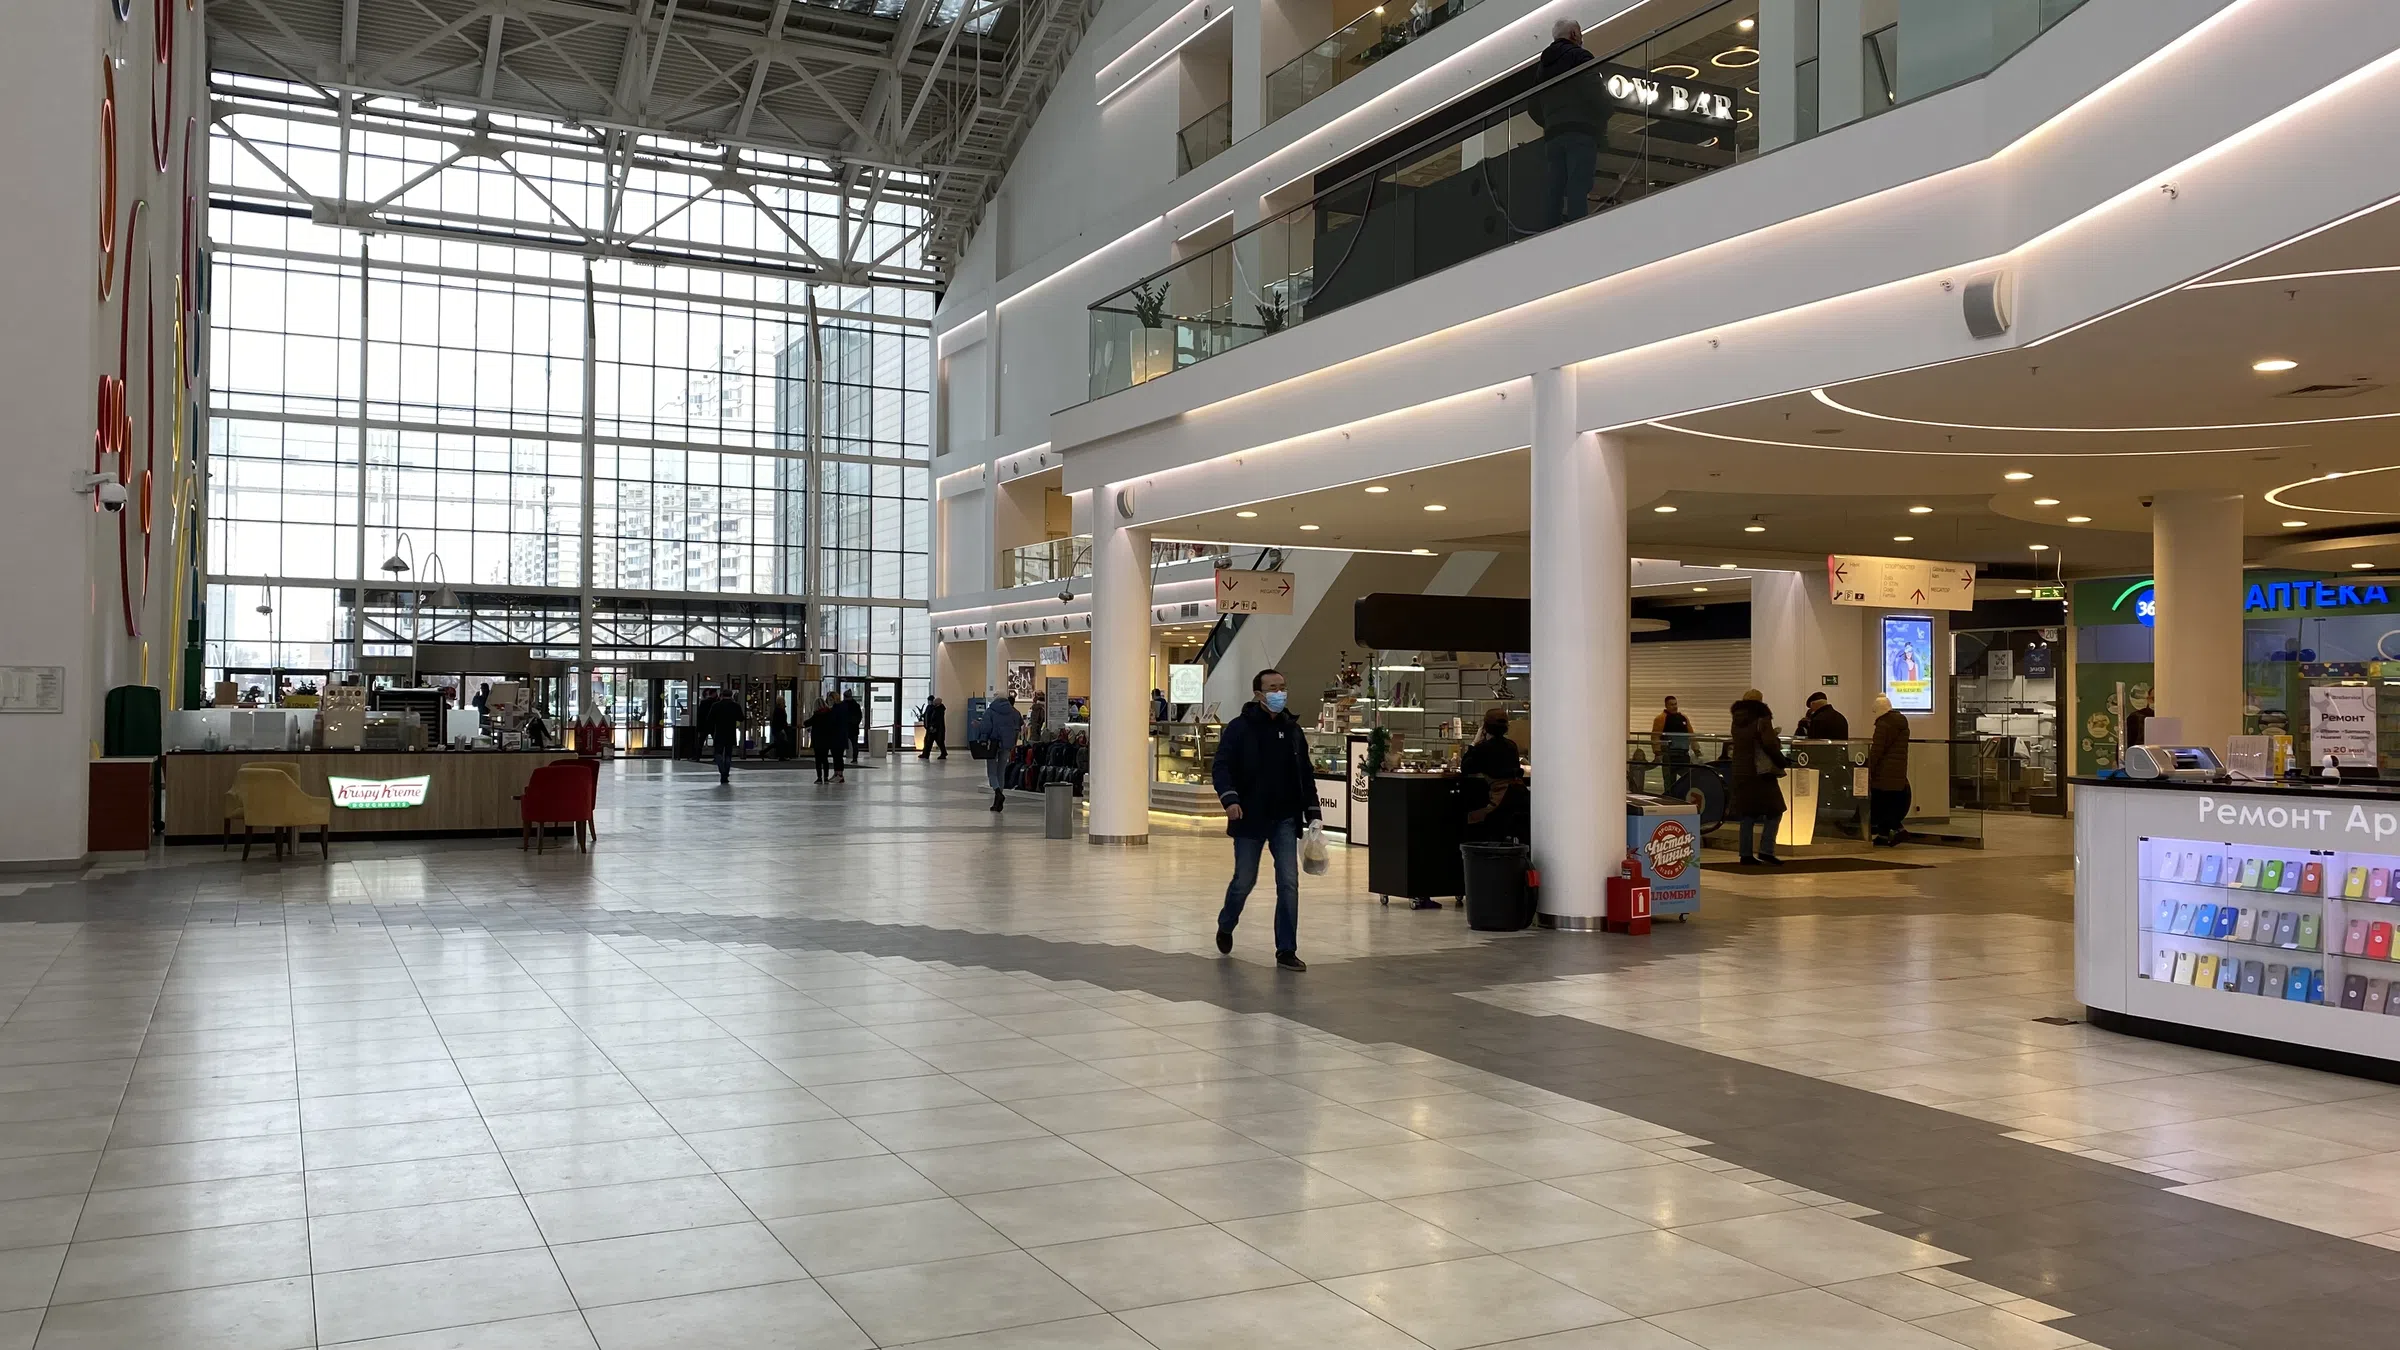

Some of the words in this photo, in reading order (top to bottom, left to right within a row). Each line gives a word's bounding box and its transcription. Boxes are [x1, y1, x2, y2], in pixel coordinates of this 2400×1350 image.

[1599, 73, 1659, 105] OW
[1670, 86, 1733, 120] BAR
[2244, 580, 2389, 610] АПТЕКА
[2322, 713, 2365, 722] Ремонт
[338, 784, 381, 801] Krispy
[381, 784, 423, 798] Kreme
[2198, 796, 2332, 830] Ремонт
[1658, 825, 1681, 836] ПРОДУКТ
[1645, 833, 1695, 856] Чистая
[1650, 847, 1694, 870] Линия
